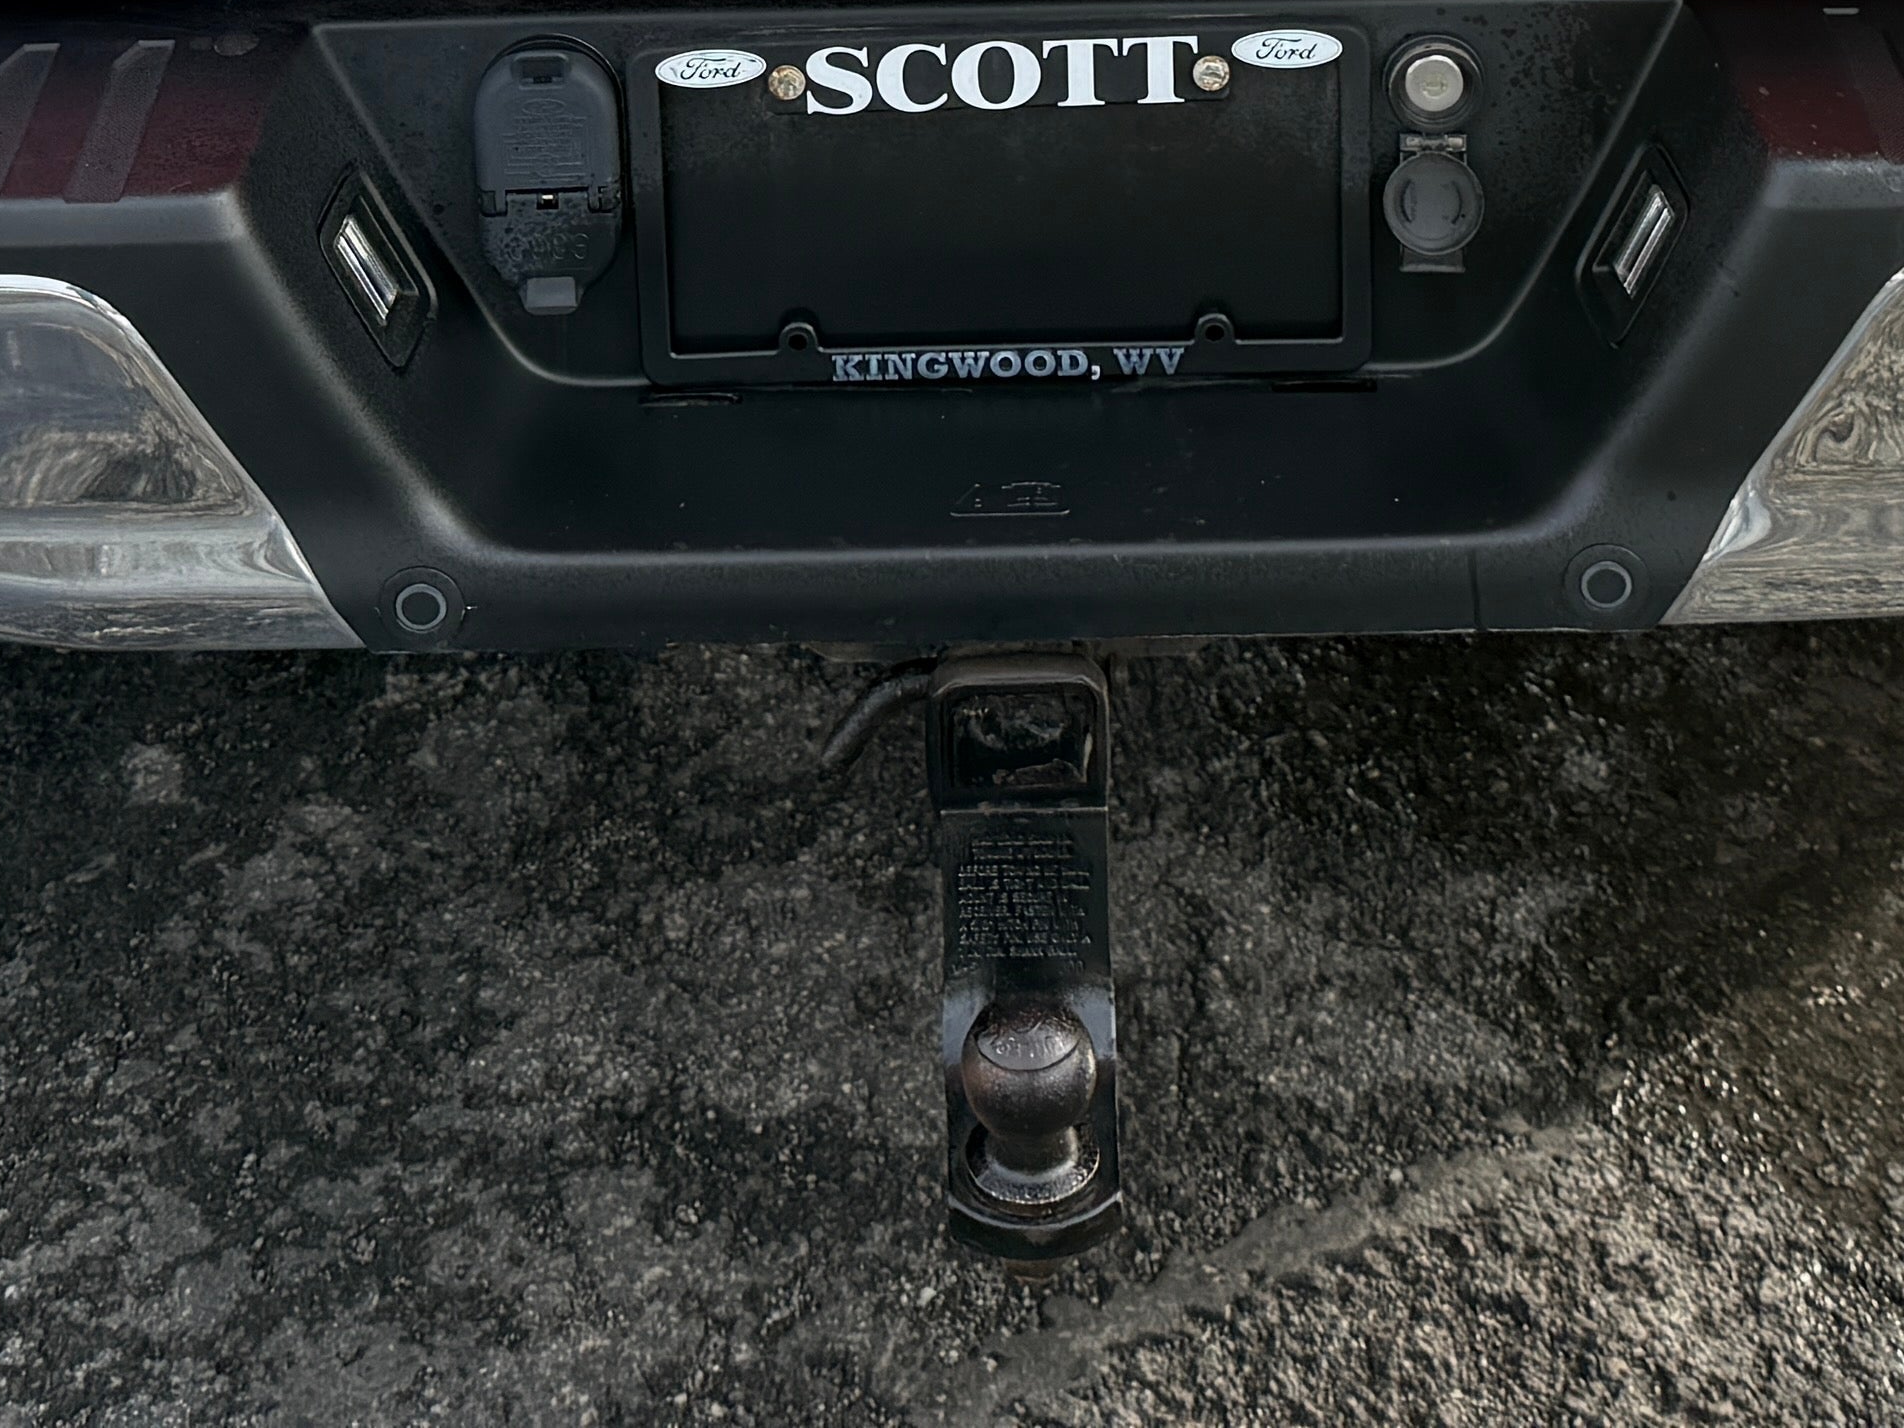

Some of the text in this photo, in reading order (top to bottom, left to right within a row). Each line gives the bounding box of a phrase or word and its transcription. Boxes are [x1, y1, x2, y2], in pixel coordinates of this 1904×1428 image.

[1255, 37, 1318, 60] Ford
[679, 56, 742, 81] Ford
[805, 35, 1198, 115] SCOTT
[831, 347, 1185, 382] KINGWOOD, WV
